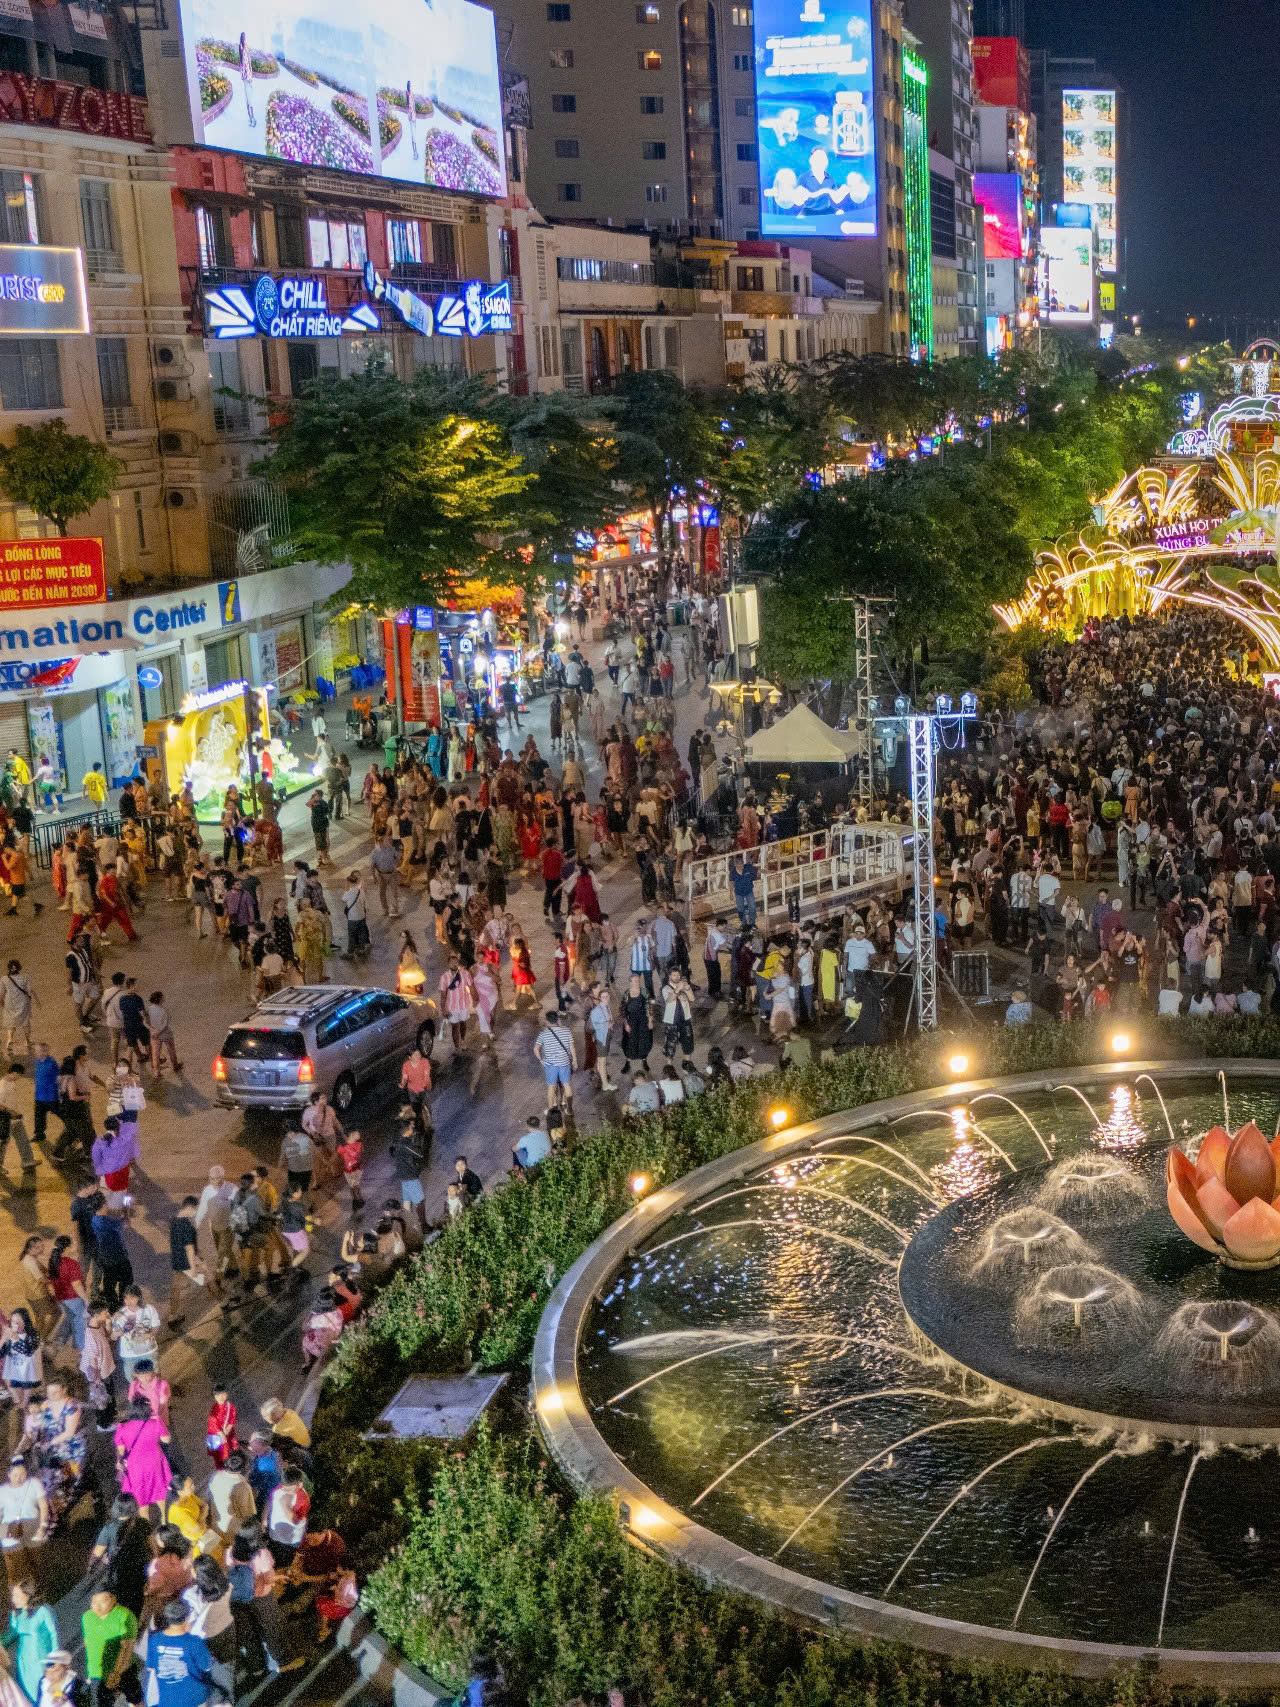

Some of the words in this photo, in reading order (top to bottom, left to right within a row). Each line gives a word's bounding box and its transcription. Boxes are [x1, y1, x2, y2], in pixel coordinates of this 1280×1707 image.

[54, 84, 152, 142] ZONE
[281, 280, 327, 309] CHILL
[485, 297, 511, 315] SAIGON
[270, 311, 304, 337] CHẤT
[306, 313, 342, 336] RIÊNG
[35, 545, 62, 560] LÒNG
[23, 565, 43, 581] CÁC
[45, 566, 68, 581] MỤC
[70, 562, 92, 578] TIÊU
[22, 584, 44, 601] ĐẾN
[133, 600, 207, 635] Center
